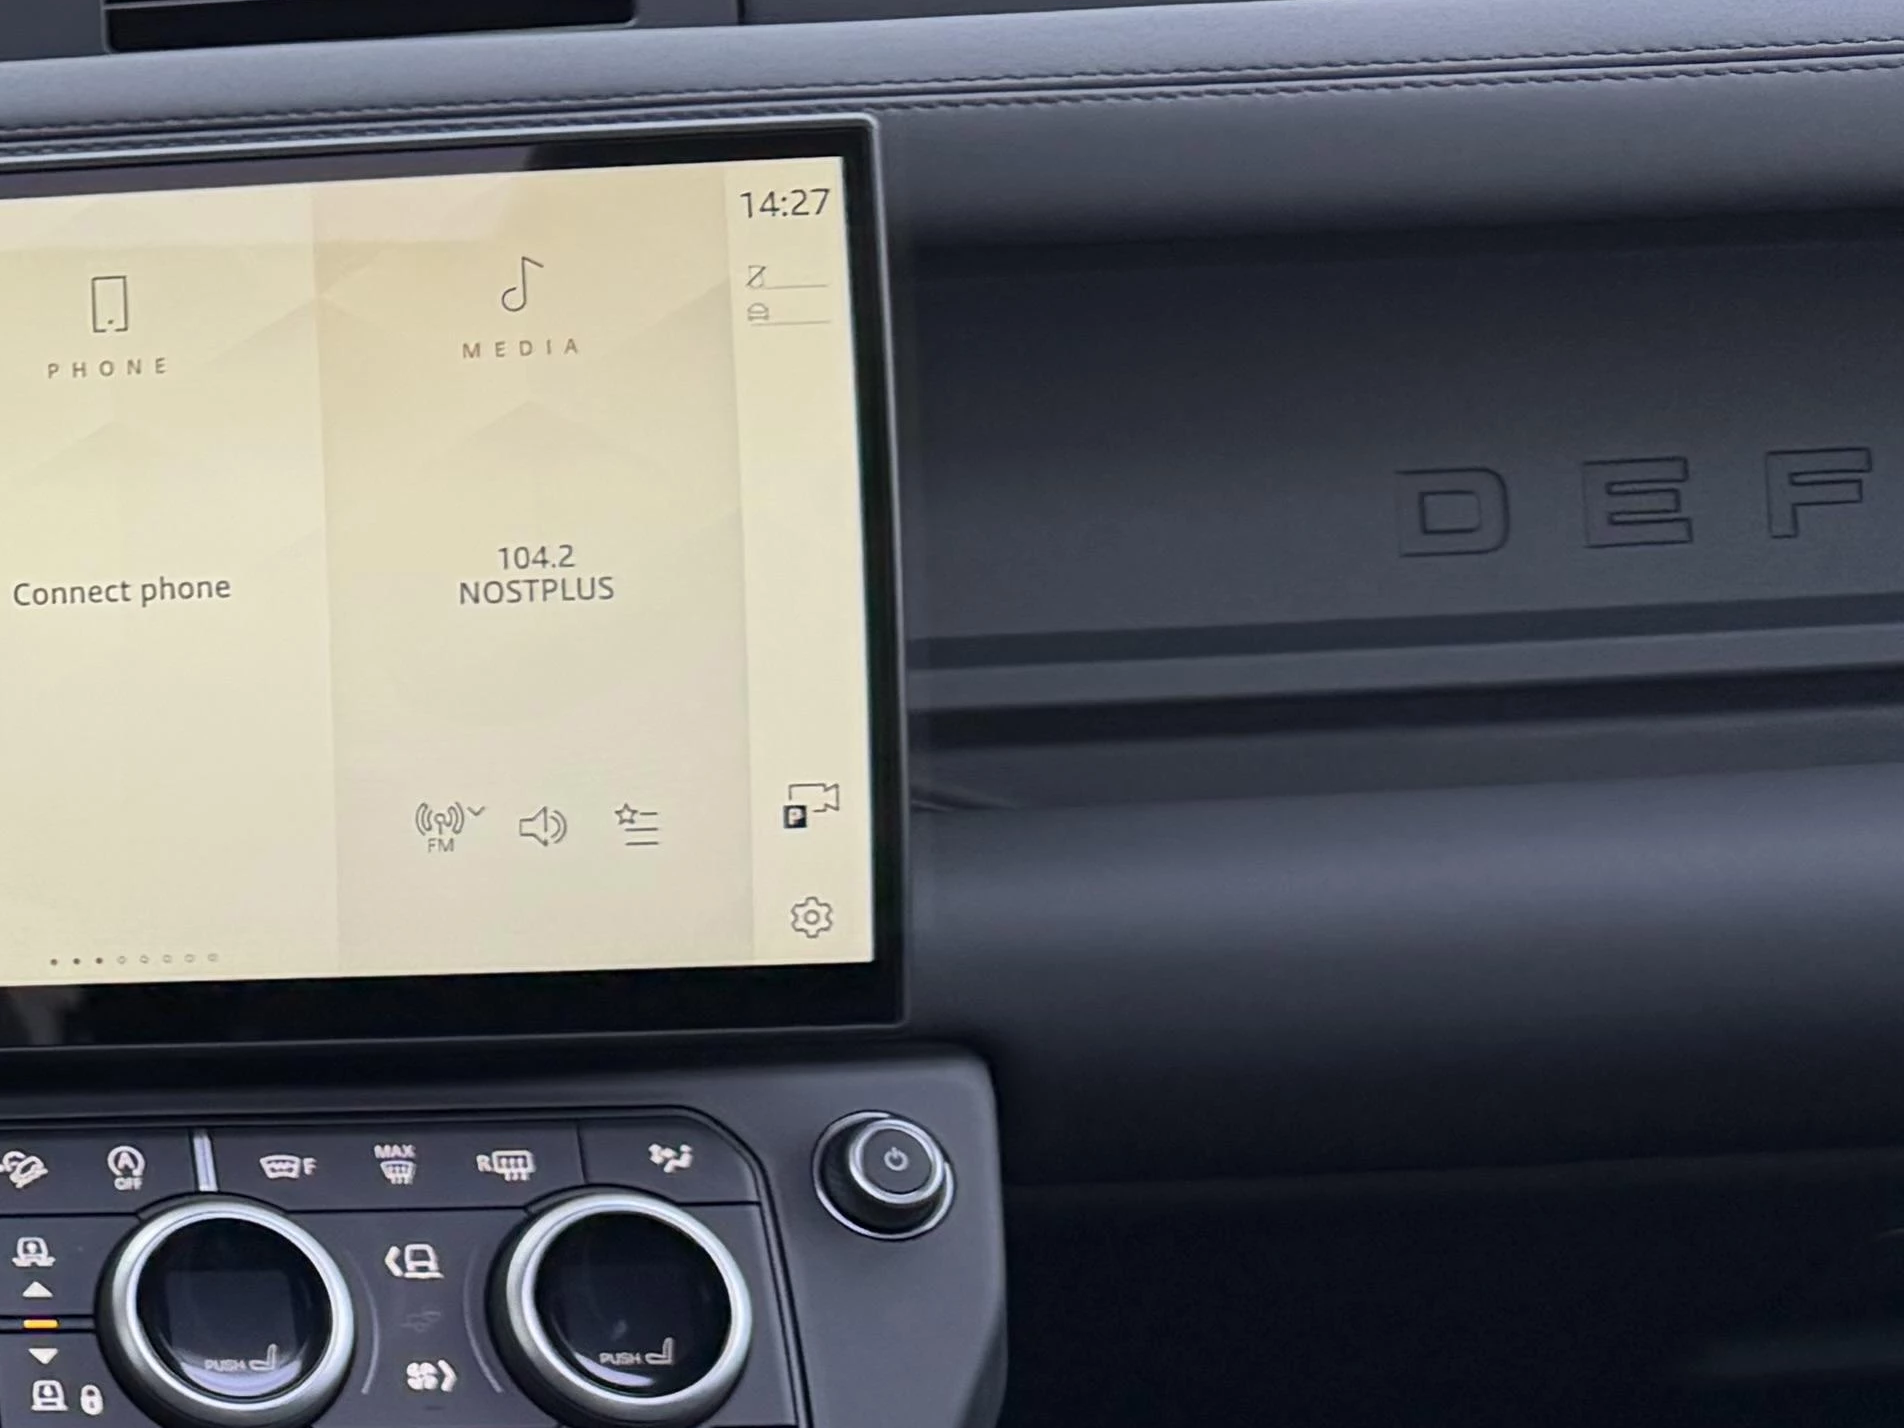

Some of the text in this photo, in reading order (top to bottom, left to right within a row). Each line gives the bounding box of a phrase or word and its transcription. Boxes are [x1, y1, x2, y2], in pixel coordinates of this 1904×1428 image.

[740, 187, 831, 218] 14:27
[461, 337, 580, 361] MEDIA
[47, 356, 169, 380] PHONE
[1394, 446, 1874, 559] DEF
[498, 544, 576, 570] 104.2
[12, 576, 232, 608] Connect phone
[459, 576, 615, 604] NOSTPLUS
[427, 838, 455, 853] FM
[373, 1144, 416, 1159] MAX
[303, 1157, 318, 1175] F
[476, 1154, 493, 1172] R
[114, 1177, 143, 1190] OFF
[204, 1358, 247, 1372] PUSH
[599, 1352, 641, 1365] PUSH
